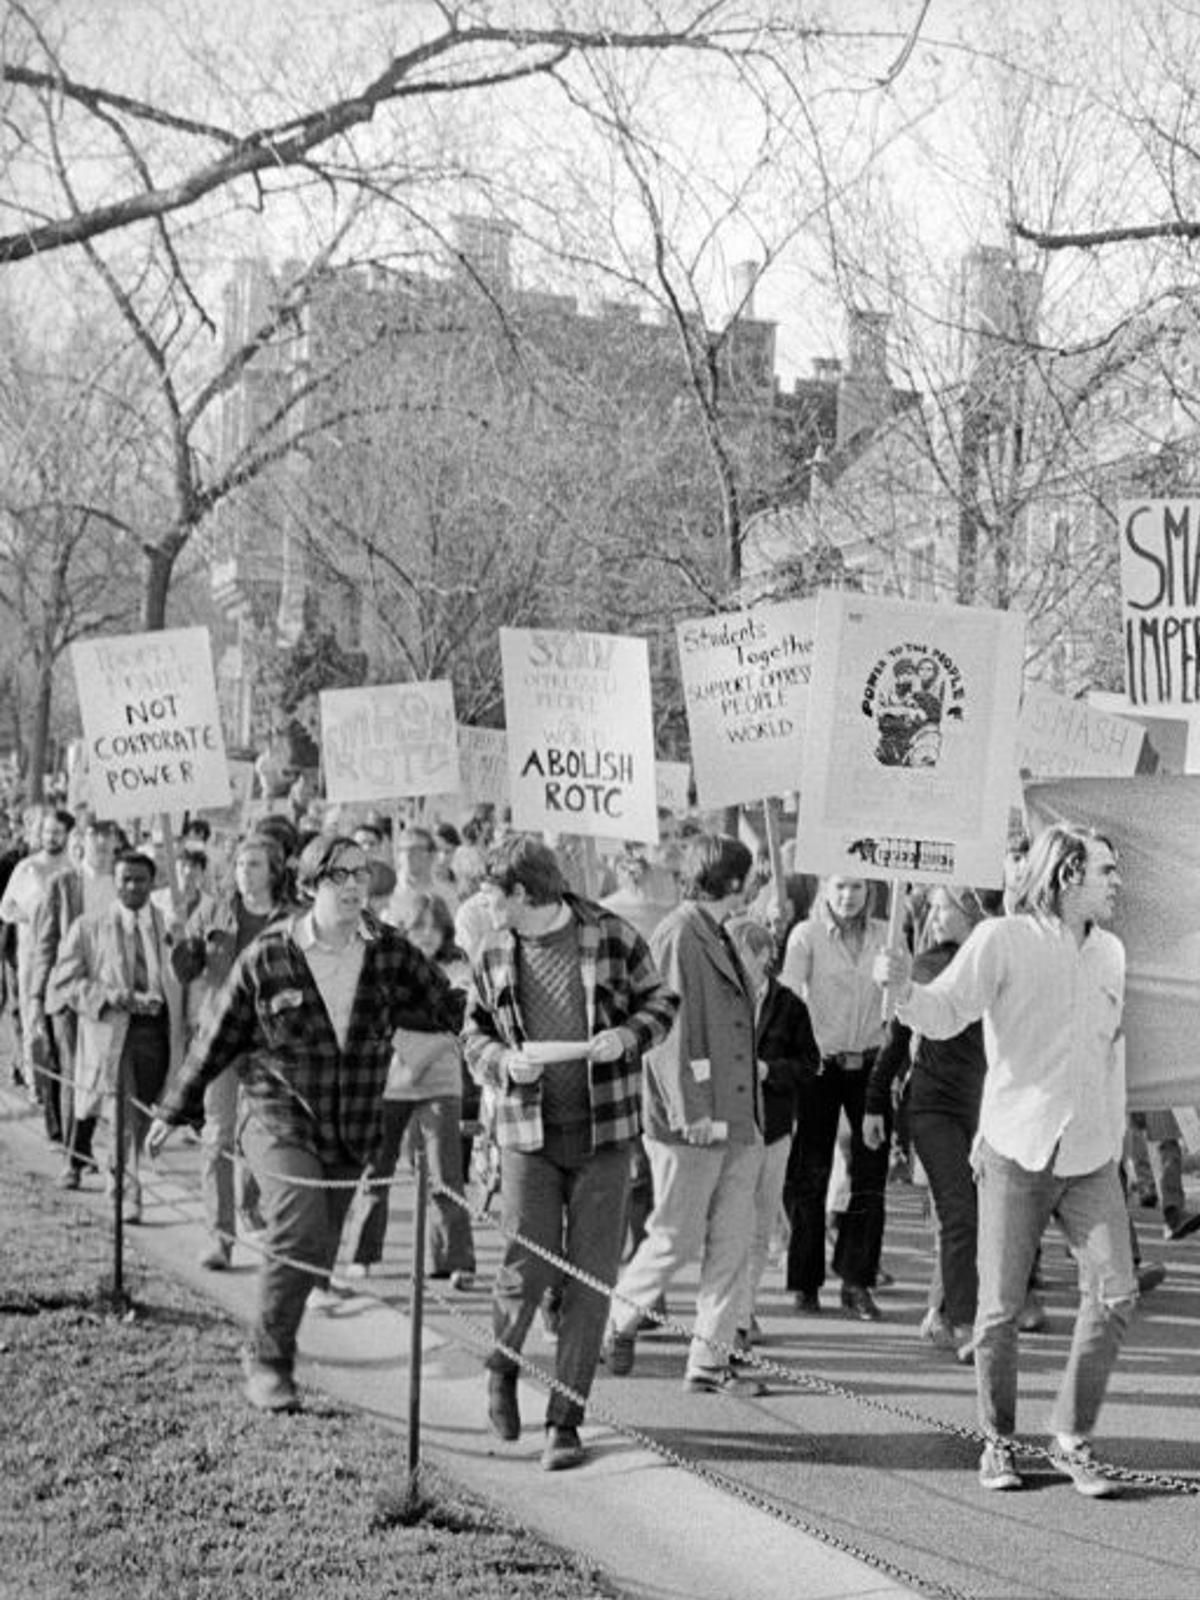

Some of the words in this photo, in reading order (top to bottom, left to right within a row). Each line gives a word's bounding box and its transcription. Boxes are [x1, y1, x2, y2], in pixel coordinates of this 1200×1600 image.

[684, 618, 768, 653] Students
[737, 634, 814, 670] Togethe
[862, 660, 887, 718] POWER
[888, 646, 903, 657] TO
[904, 643, 928, 655] THE
[932, 648, 965, 701] PEOPLE
[125, 693, 180, 726] NOT
[721, 689, 788, 716] PEOPLE
[94, 725, 218, 760] CORPORATE
[726, 719, 794, 743] WORLD
[1031, 699, 1130, 759] SMASH
[106, 761, 194, 795] POWER
[520, 749, 634, 784] ABOLISH
[545, 781, 623, 819] ROTC
